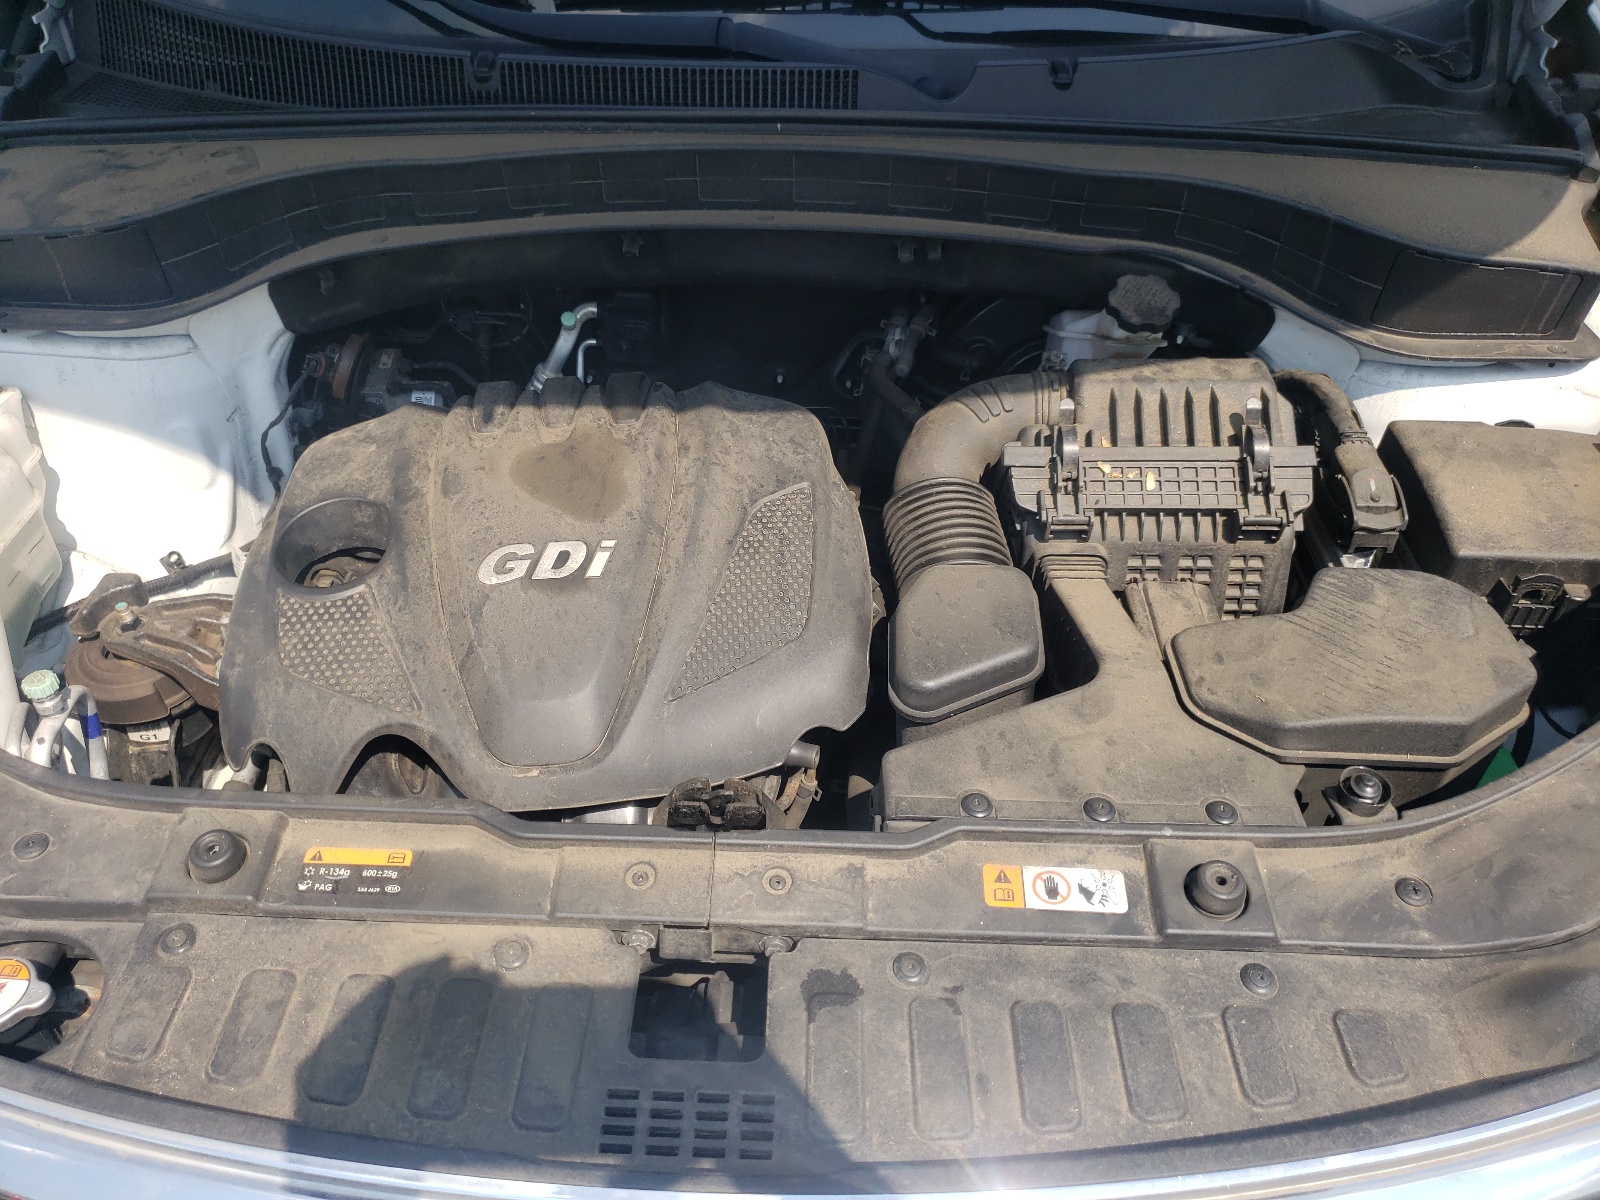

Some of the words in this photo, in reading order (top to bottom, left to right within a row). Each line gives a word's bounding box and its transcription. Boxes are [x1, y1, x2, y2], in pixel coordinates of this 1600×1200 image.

[477, 540, 617, 584] GDi
[139, 733, 158, 741] G1
[319, 867, 351, 876] R-134a
[362, 869, 398, 879] 600±25g
[314, 883, 333, 891] PAG
